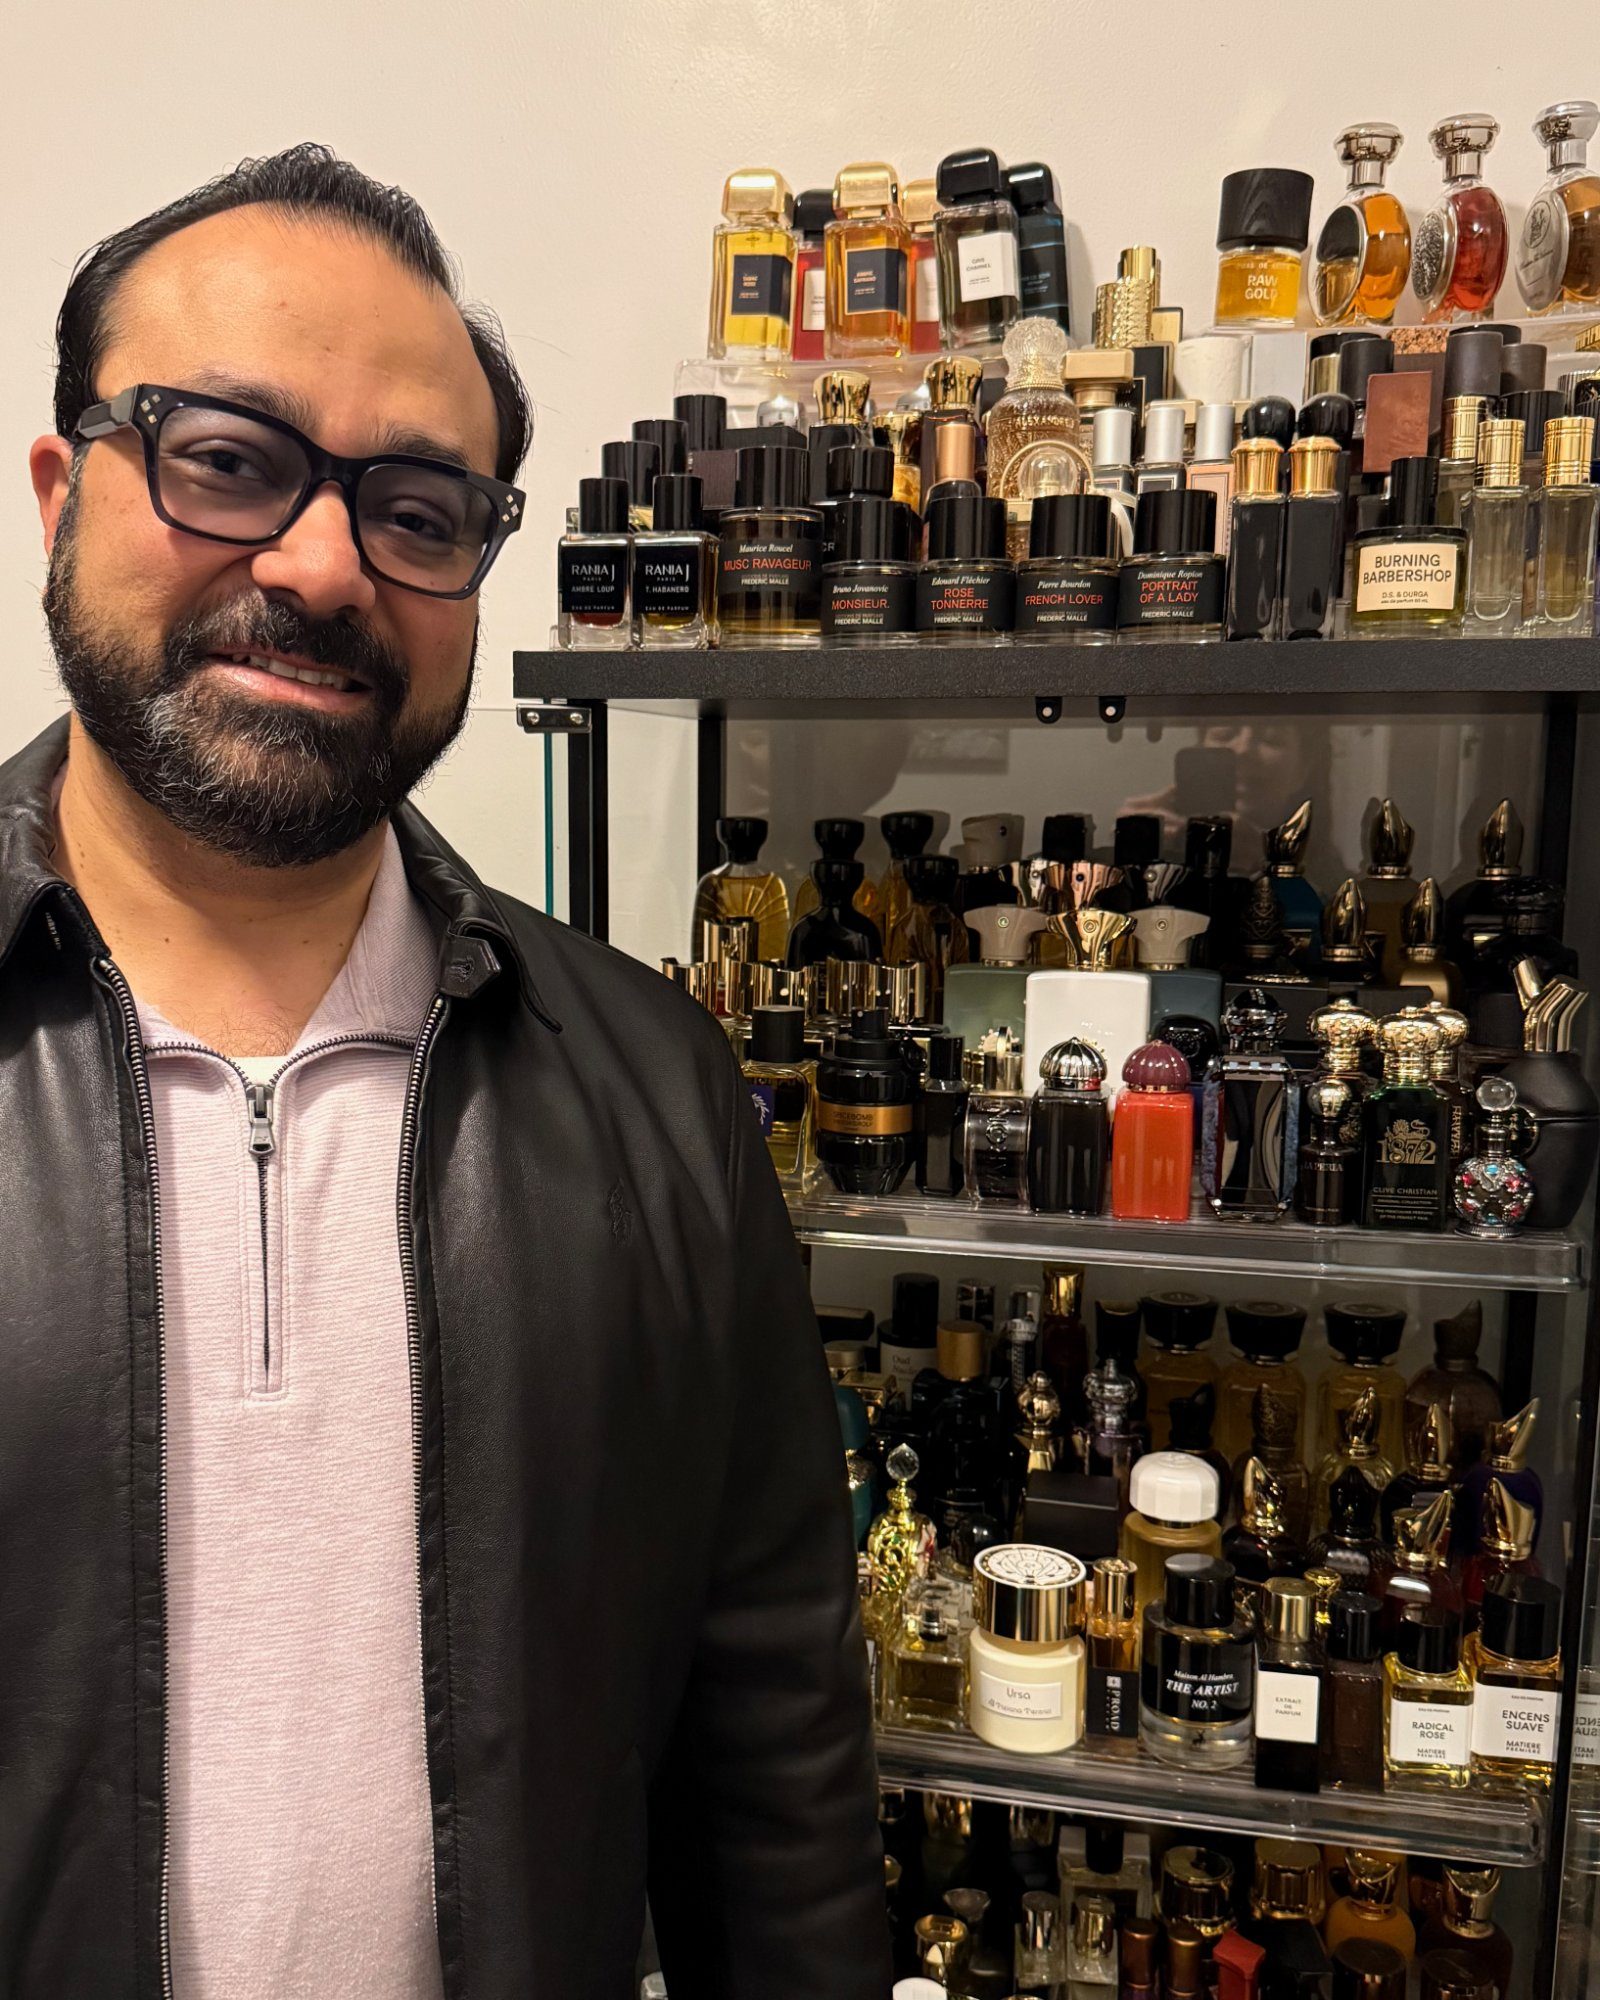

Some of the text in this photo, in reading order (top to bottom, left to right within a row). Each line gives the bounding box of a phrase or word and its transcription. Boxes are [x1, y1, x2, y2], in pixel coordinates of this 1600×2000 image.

[1248, 275, 1277, 287] RAW
[1244, 288, 1278, 300] GOLD
[739, 543, 793, 553] Maurice Roucel
[724, 558, 811, 571] MUSC RAVAGEUR
[1375, 554, 1441, 568] BURNING
[571, 564, 615, 583] RANIA J
[645, 564, 690, 583] RANIA J
[1137, 570, 1203, 580] Dominique Ropion
[1363, 569, 1452, 584] BARBERSHOP
[931, 576, 960, 586] Edouard
[1037, 579, 1091, 589] Pierre Bourdon
[1141, 581, 1198, 592] PORTRAIT
[571, 585, 615, 593] AMBRE LOUP
[652, 585, 690, 593] HABANERO
[832, 585, 852, 594] Bruno
[944, 587, 975, 598] ROSE
[1025, 593, 1104, 605] FRENCH LOVER
[1140, 592, 1199, 604] OF A LADY
[831, 599, 890, 610] MONSIEUR.
[930, 600, 989, 610] TONNERRE
[1066, 614, 1088, 622] MALLE
[1172, 610, 1194, 618] MALLE
[1376, 1138, 1437, 1165] 1872
[1174, 1670, 1198, 1680] Maison
[1166, 1679, 1239, 1696] THE ARTIST
[1006, 1687, 1031, 1700] Ursa
[1191, 1700, 1217, 1710] NO. 2
[1502, 1710, 1550, 1723] ENCENS
[1412, 1721, 1454, 1732] RADICAL
[1505, 1720, 1544, 1733] SUAVE
[1419, 1731, 1446, 1740] ROSE
[1506, 1740, 1541, 1749] MATIERE
[1417, 1748, 1446, 1756] MATIERE
